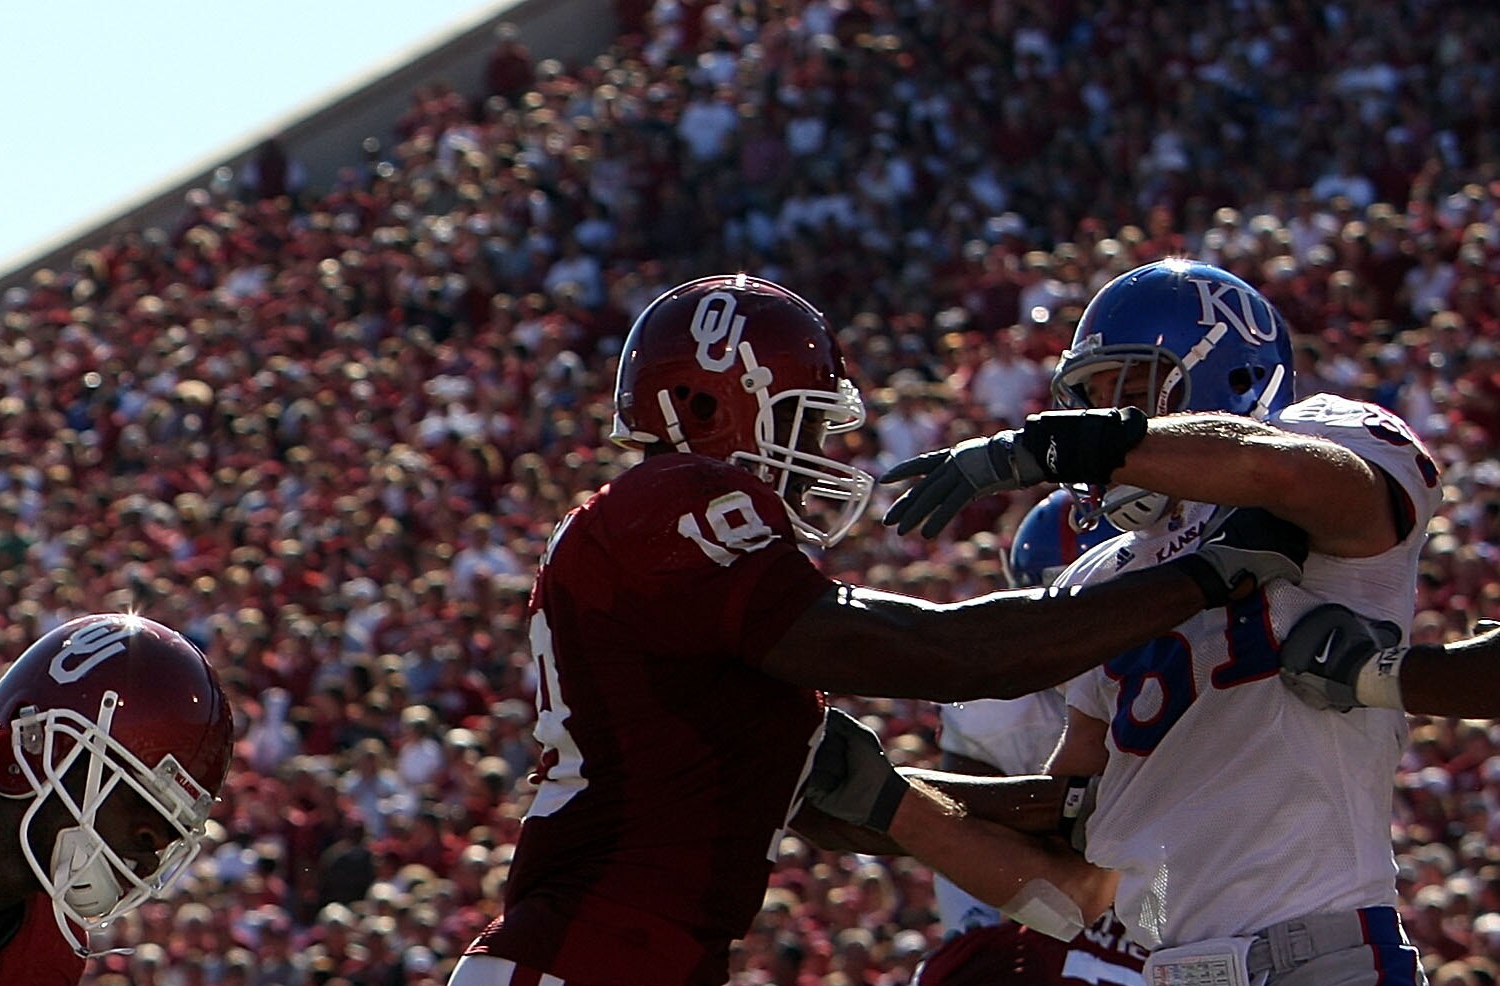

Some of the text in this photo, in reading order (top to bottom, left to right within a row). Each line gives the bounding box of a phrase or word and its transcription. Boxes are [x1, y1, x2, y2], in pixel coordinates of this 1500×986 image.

[690, 291, 746, 373] OU
[1187, 278, 1277, 346] KU
[1155, 520, 1206, 563] KANSA
[48, 620, 135, 685] OU
